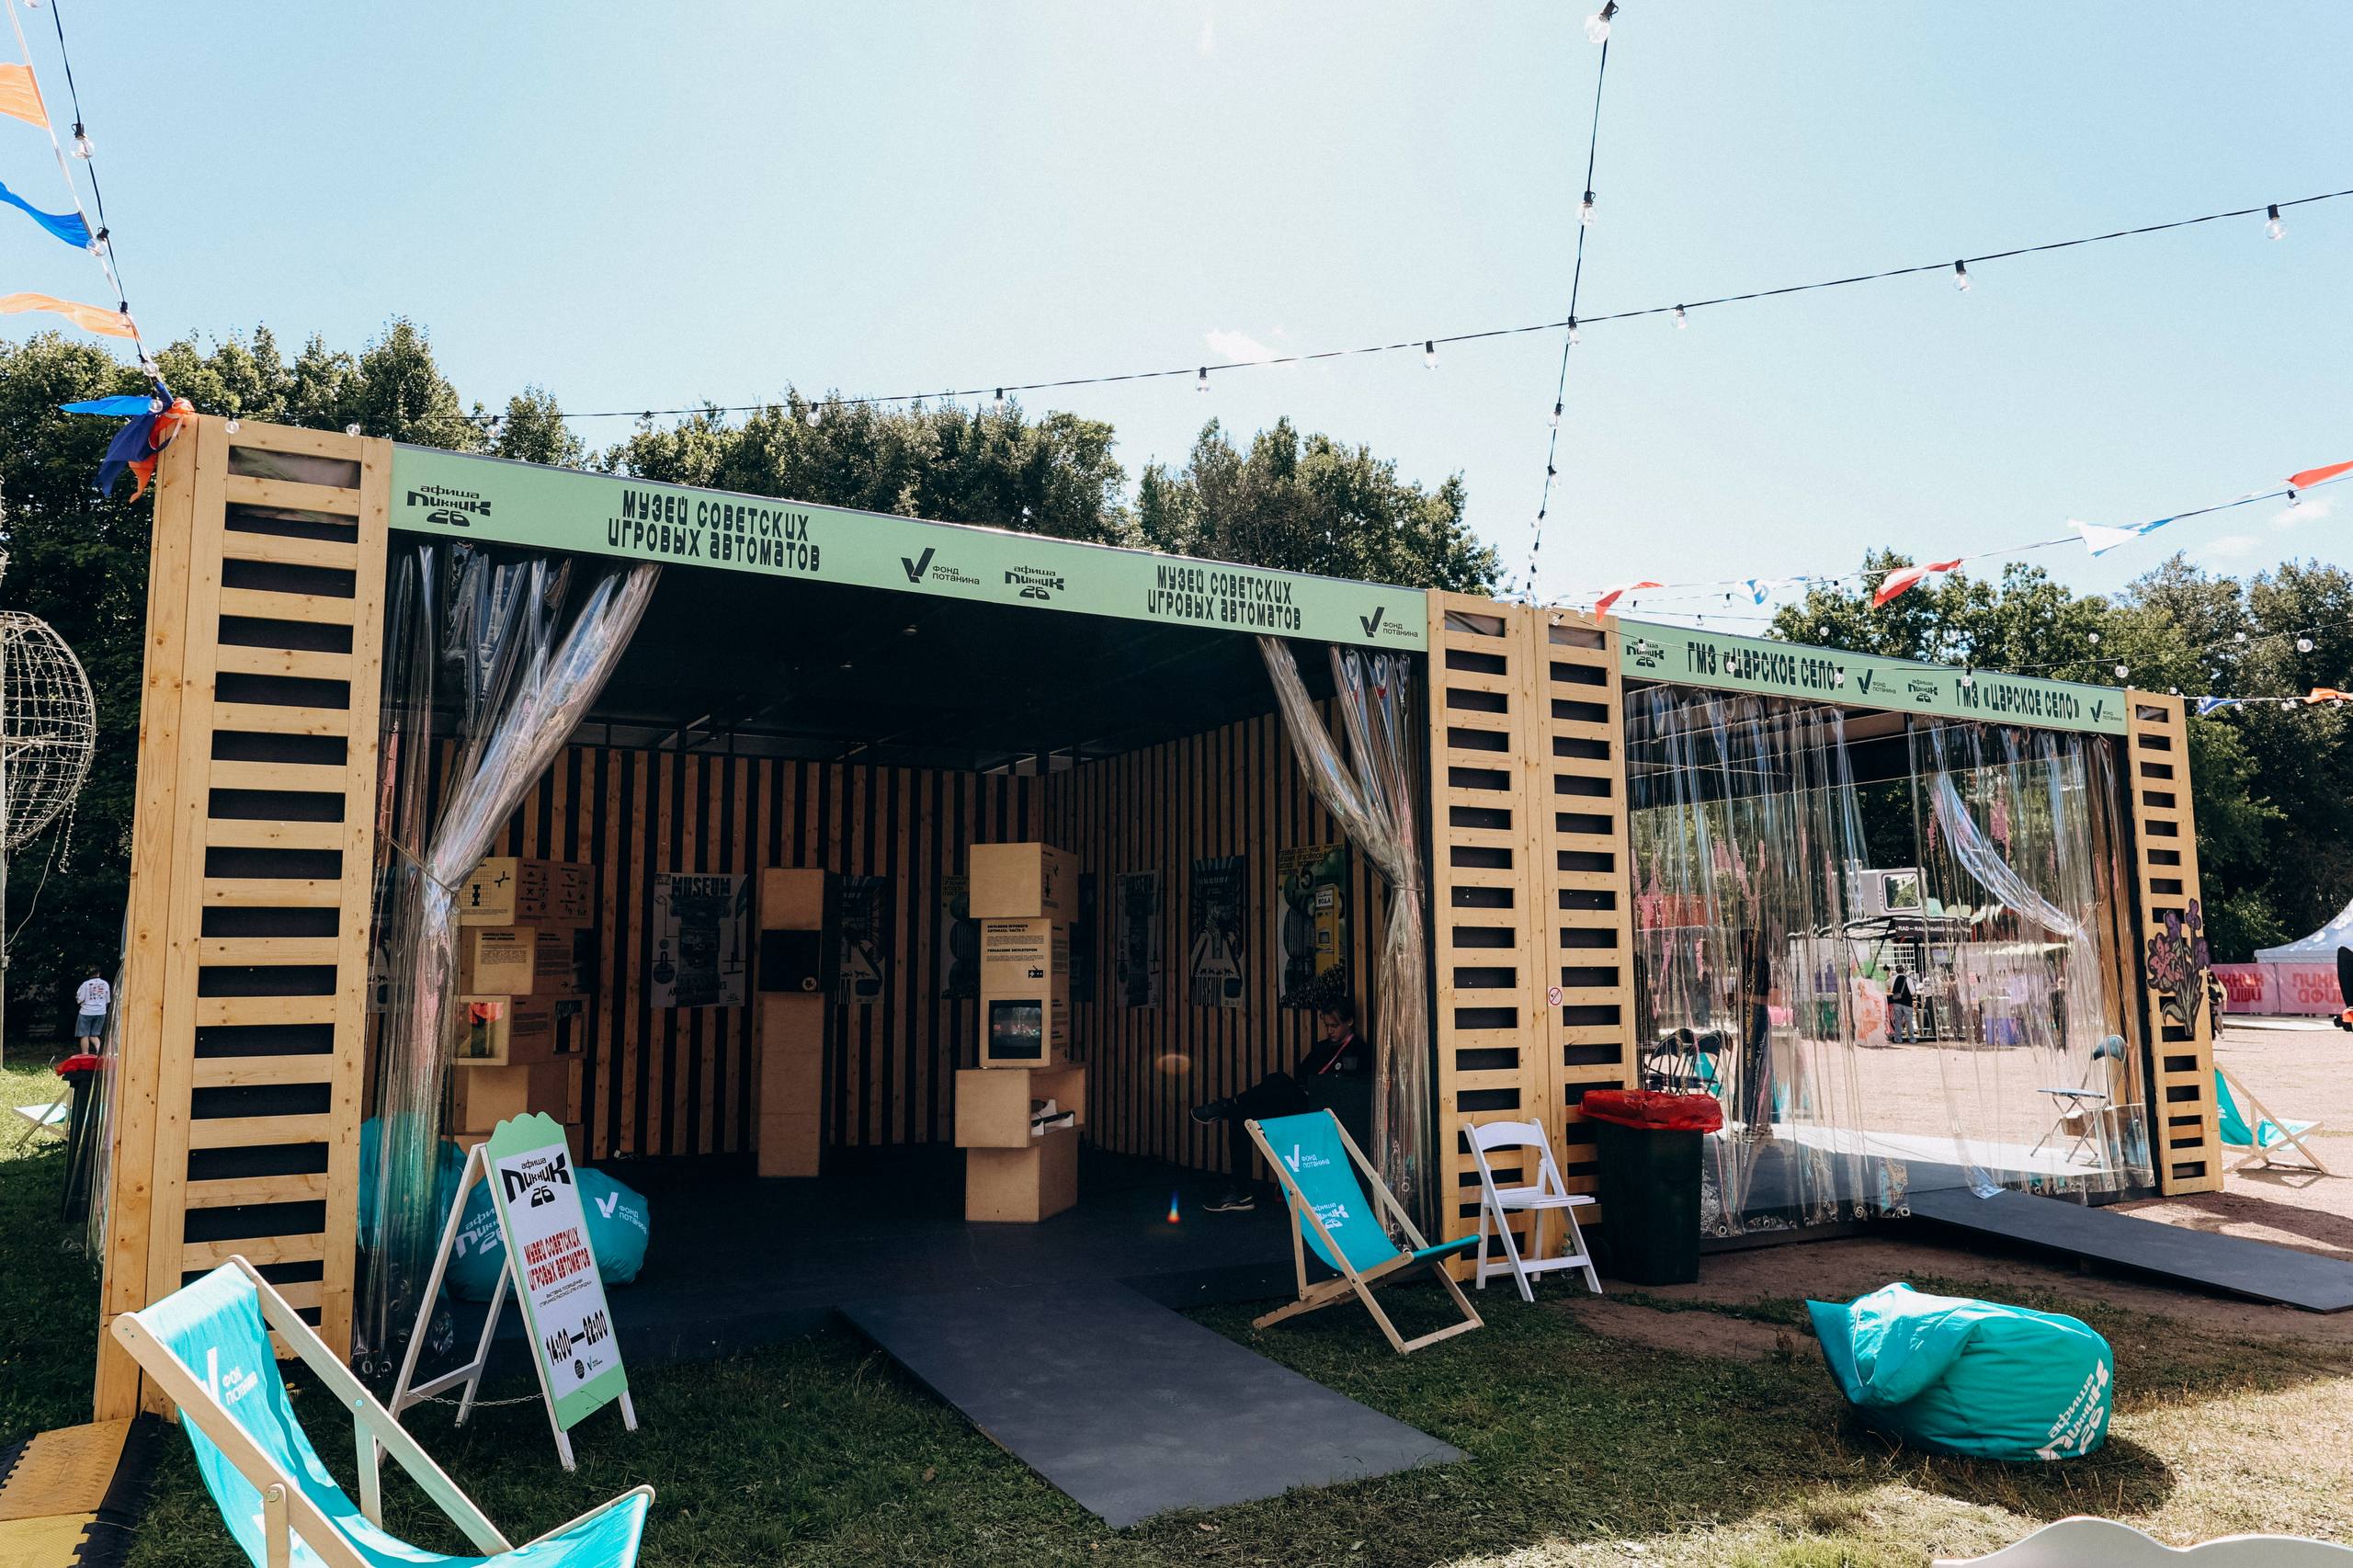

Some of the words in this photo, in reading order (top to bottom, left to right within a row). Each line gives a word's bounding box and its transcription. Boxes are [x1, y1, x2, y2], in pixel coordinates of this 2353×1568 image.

[420, 485, 480, 499] афиша
[426, 508, 471, 528] 26
[622, 490, 688, 526] МУЗЕЙ
[697, 500, 810, 542] СОВЕТСКИХ
[608, 517, 701, 557] ИГРОВЫХ
[710, 532, 820, 572] АВТОМАТОВ
[932, 565, 960, 575] ФОНД
[932, 573, 980, 585] ПОТАНИНА
[1014, 565, 1056, 577] афиша
[1019, 585, 1051, 600] 26
[1157, 564, 1204, 594] МУЗЕЙ
[1210, 572, 1292, 605] СОВЕТСКИХ
[1148, 589, 1214, 620] ИГРОВЫХ
[1221, 598, 1302, 631] АВТОМАТОВ
[1636, 656, 1656, 668] 26
[1687, 641, 1716, 676] ГМЗ
[1955, 678, 1979, 709] ГМЗ
[672, 877, 732, 898] MUSEUM
[521, 1157, 547, 1170] афиша
[530, 1185, 556, 1209] 26
[464, 1208, 495, 1231] афи
[619, 1205, 639, 1219] ФОНД
[524, 1238, 547, 1267] МУЗЕЙ
[545, 1226, 582, 1258] СОВЕТСКИХ
[527, 1260, 559, 1291] ИГРОВЫХ
[2048, 1373, 2095, 1439] афиша
